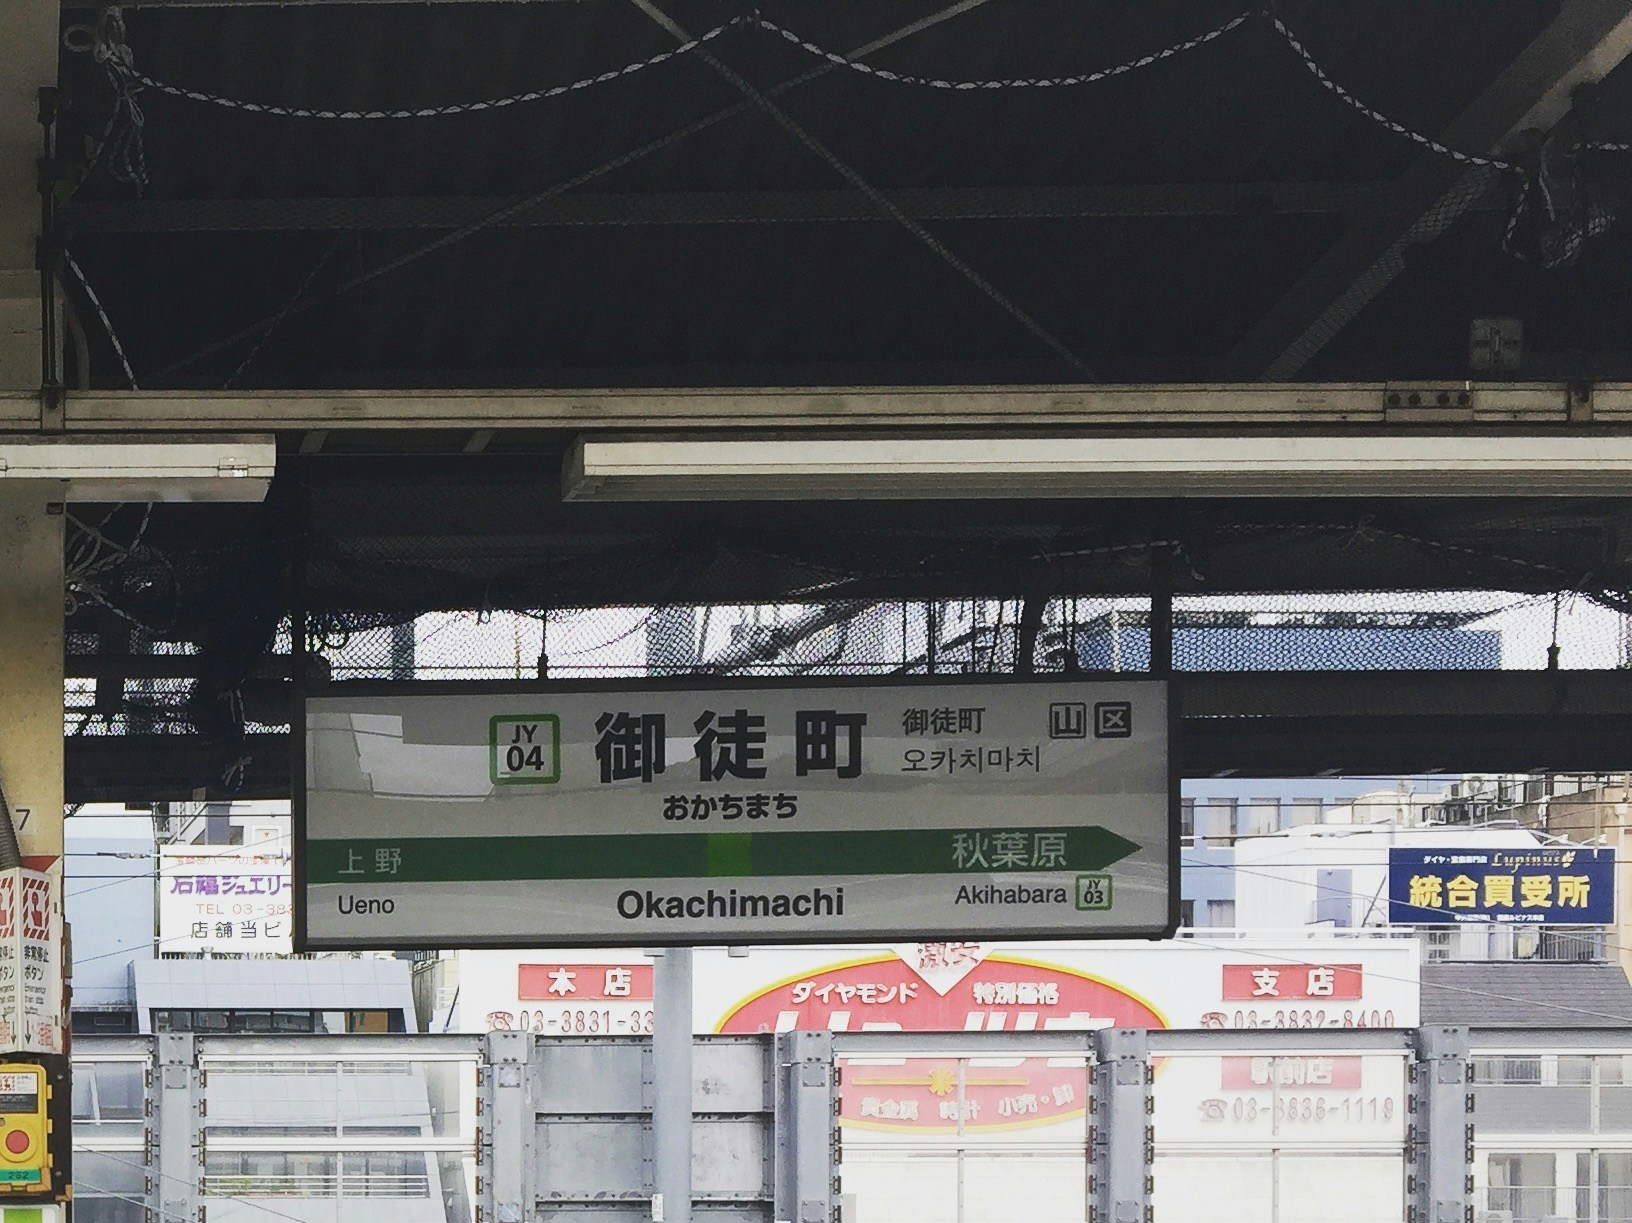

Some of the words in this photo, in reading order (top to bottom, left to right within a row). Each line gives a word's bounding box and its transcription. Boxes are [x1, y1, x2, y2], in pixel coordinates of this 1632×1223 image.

[511, 724, 539, 744] JY
[901, 707, 986, 736] 御徒町
[1054, 706, 1082, 735] 山
[1098, 706, 1128, 735] 区
[506, 745, 545, 772] 04
[594, 709, 867, 783] 御徒町
[901, 745, 1042, 775] 오카치마치
[662, 793, 798, 822] おかちまち
[338, 847, 402, 875] 上野
[951, 831, 1069, 870] 秋葉原
[954, 884, 1068, 906] Akihabara
[1083, 891, 1104, 905] 03
[1085, 879, 1102, 890] JY
[1409, 874, 1592, 909] 統合買受所
[195, 903, 225, 915] TEL
[337, 895, 396, 915] Ueno
[616, 887, 845, 920] Okachimachi
[191, 921, 292, 939] 店舗当ビ
[548, 967, 632, 997] 本店
[791, 982, 918, 1004] ダイヤモンド
[1252, 967, 1335, 997] 支店
